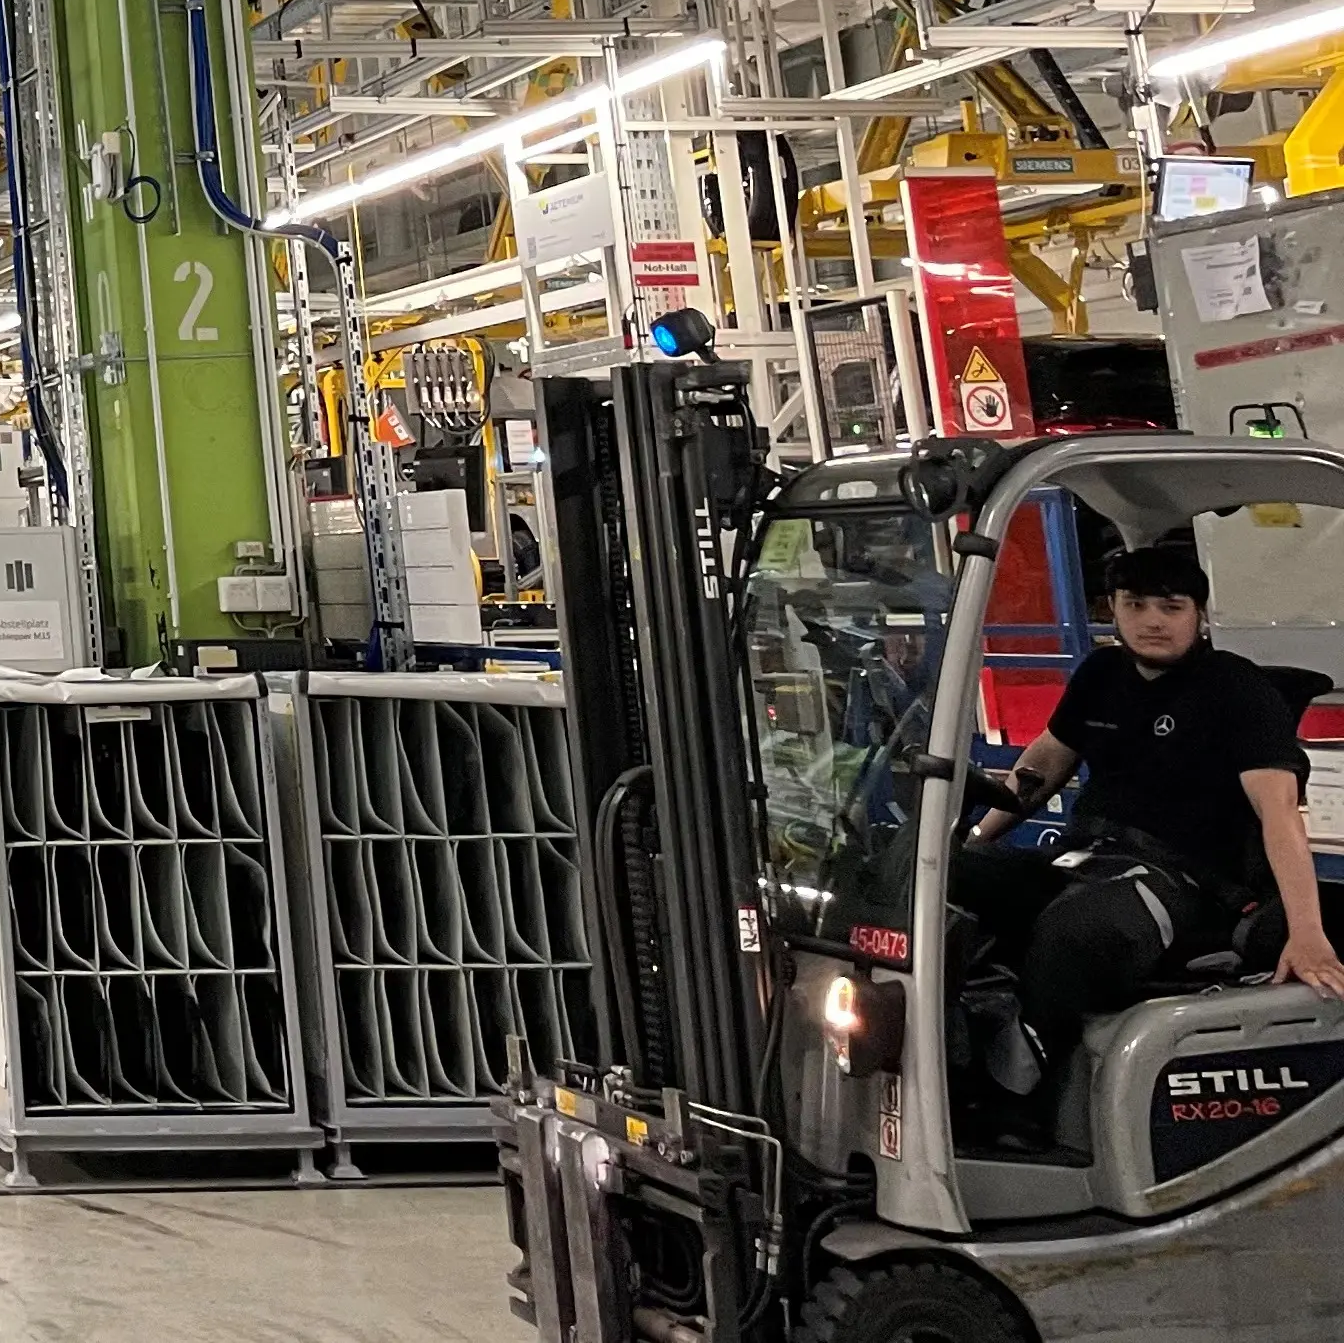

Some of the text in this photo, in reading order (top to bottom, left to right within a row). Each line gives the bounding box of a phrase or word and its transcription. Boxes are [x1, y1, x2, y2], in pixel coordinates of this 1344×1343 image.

[1015, 159, 1072, 172] SIEMENS
[643, 263, 688, 272] Not-Halt
[173, 261, 219, 341] 2
[694, 497, 720, 599] STILL
[849, 926, 908, 959] 45-0473
[1167, 1066, 1310, 1096] STILL
